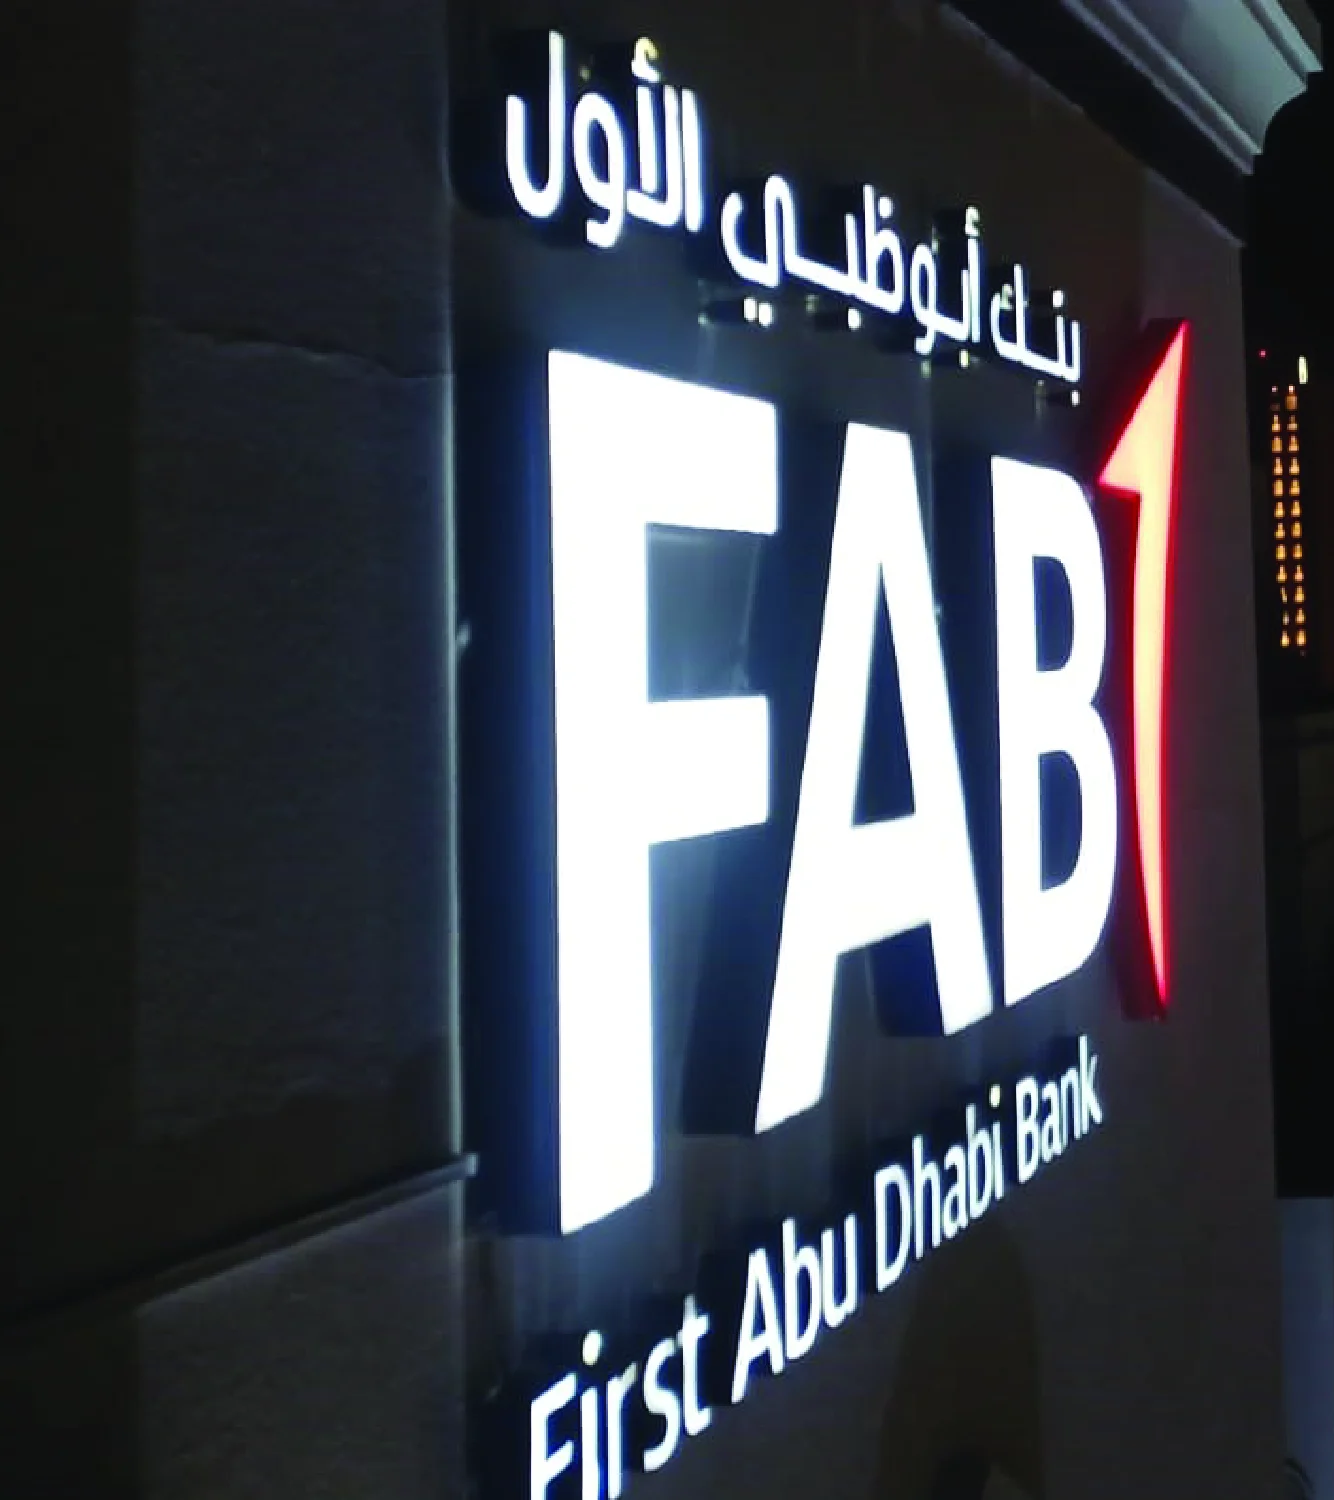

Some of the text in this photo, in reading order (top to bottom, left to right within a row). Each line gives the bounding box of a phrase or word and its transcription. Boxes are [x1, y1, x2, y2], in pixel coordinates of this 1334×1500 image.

[504, 29, 704, 250] الأول
[989, 262, 1082, 406] بنك
[529, 1034, 1104, 1500] First Abu Dhabi Bank
